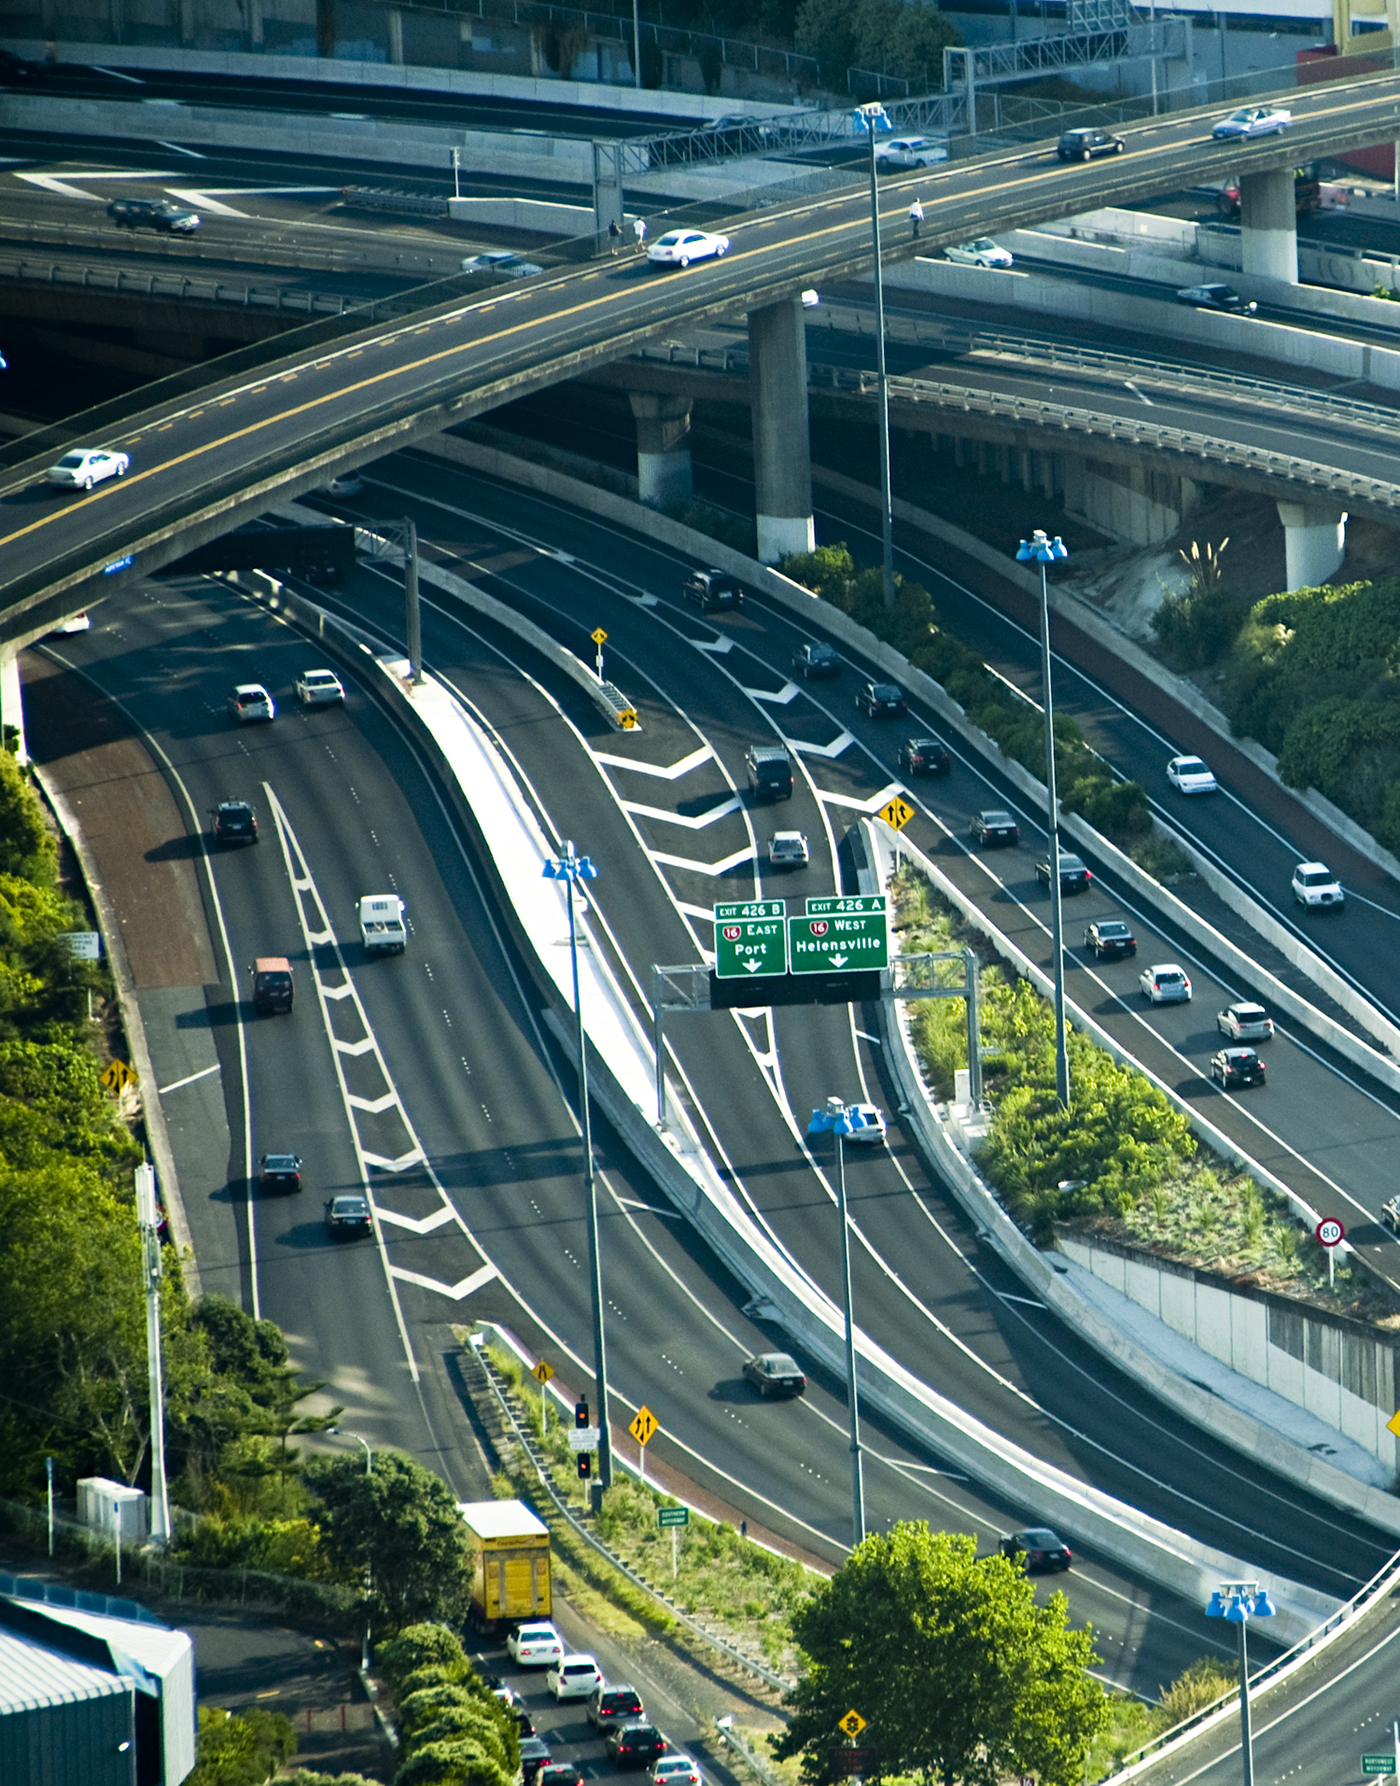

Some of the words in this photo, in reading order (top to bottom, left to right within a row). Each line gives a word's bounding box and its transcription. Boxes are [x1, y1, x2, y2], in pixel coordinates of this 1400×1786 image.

[719, 908, 737, 916] EXIT
[742, 905, 766, 916] 426
[772, 905, 780, 915] B
[811, 903, 831, 912] EXIT
[836, 900, 863, 911] 426
[871, 899, 882, 910] A
[726, 927, 737, 938] 16
[747, 925, 778, 935] EAST
[814, 922, 825, 933] 16
[834, 920, 866, 931] WEST
[735, 943, 767, 956] Port
[797, 938, 880, 952] Helensville
[1322, 1226, 1339, 1238] 80
